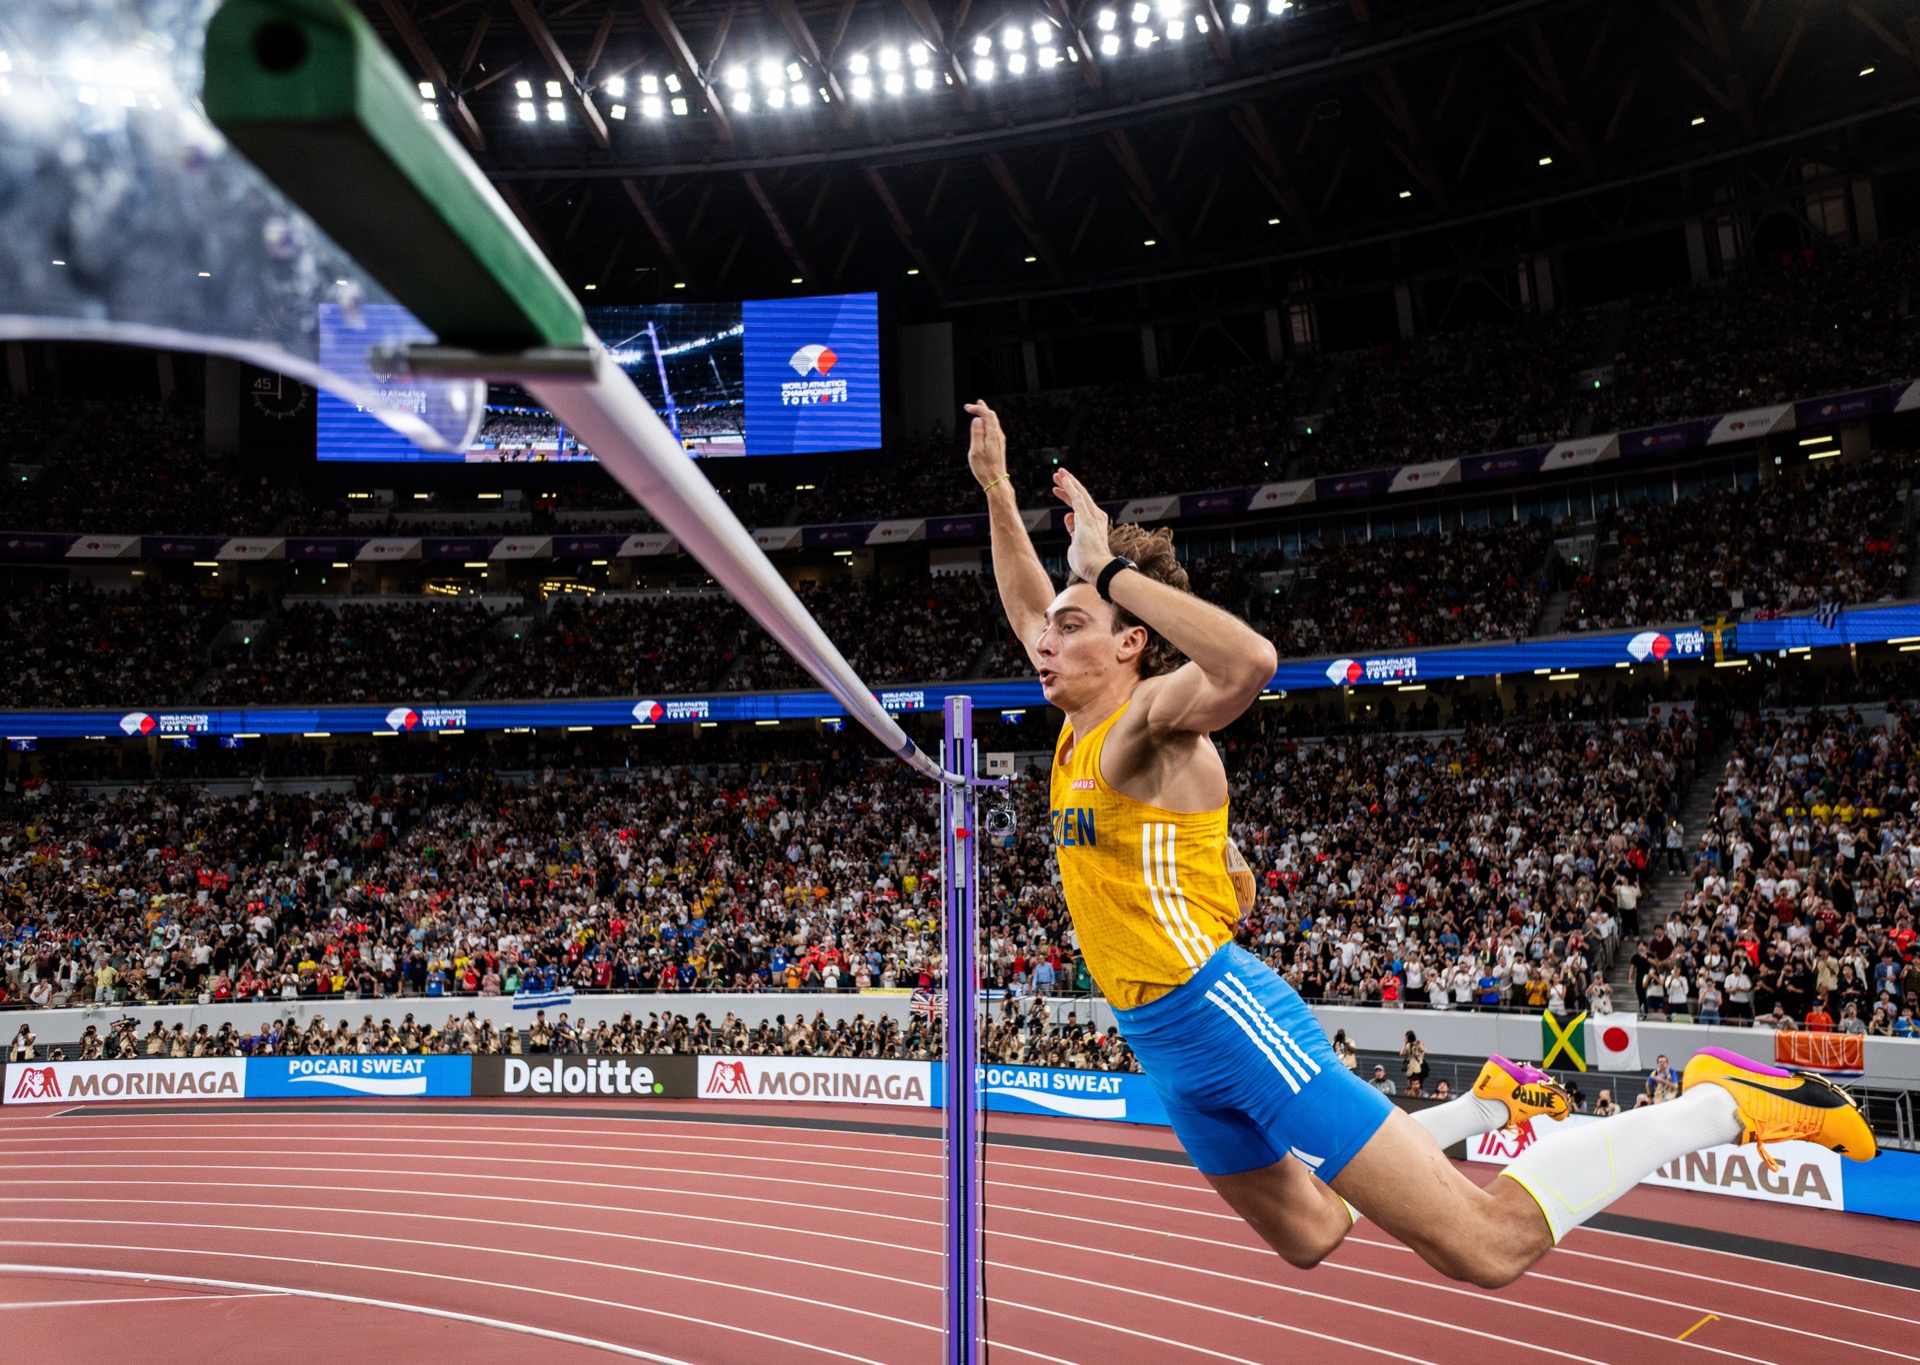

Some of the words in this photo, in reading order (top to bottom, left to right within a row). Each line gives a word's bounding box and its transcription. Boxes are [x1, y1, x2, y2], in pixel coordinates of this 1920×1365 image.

[781, 381, 808, 390] WORLD
[808, 379, 848, 389] ATHLETICS
[1775, 1029, 1860, 1067] MENNO
[288, 1059, 358, 1076] POCARI
[361, 1058, 425, 1075] SWEAT
[68, 1071, 239, 1098] MORINAGA
[758, 1071, 925, 1101] MORINAGA
[1052, 1074, 1123, 1094] SWEAT
[1655, 1150, 1833, 1202] INAGA
